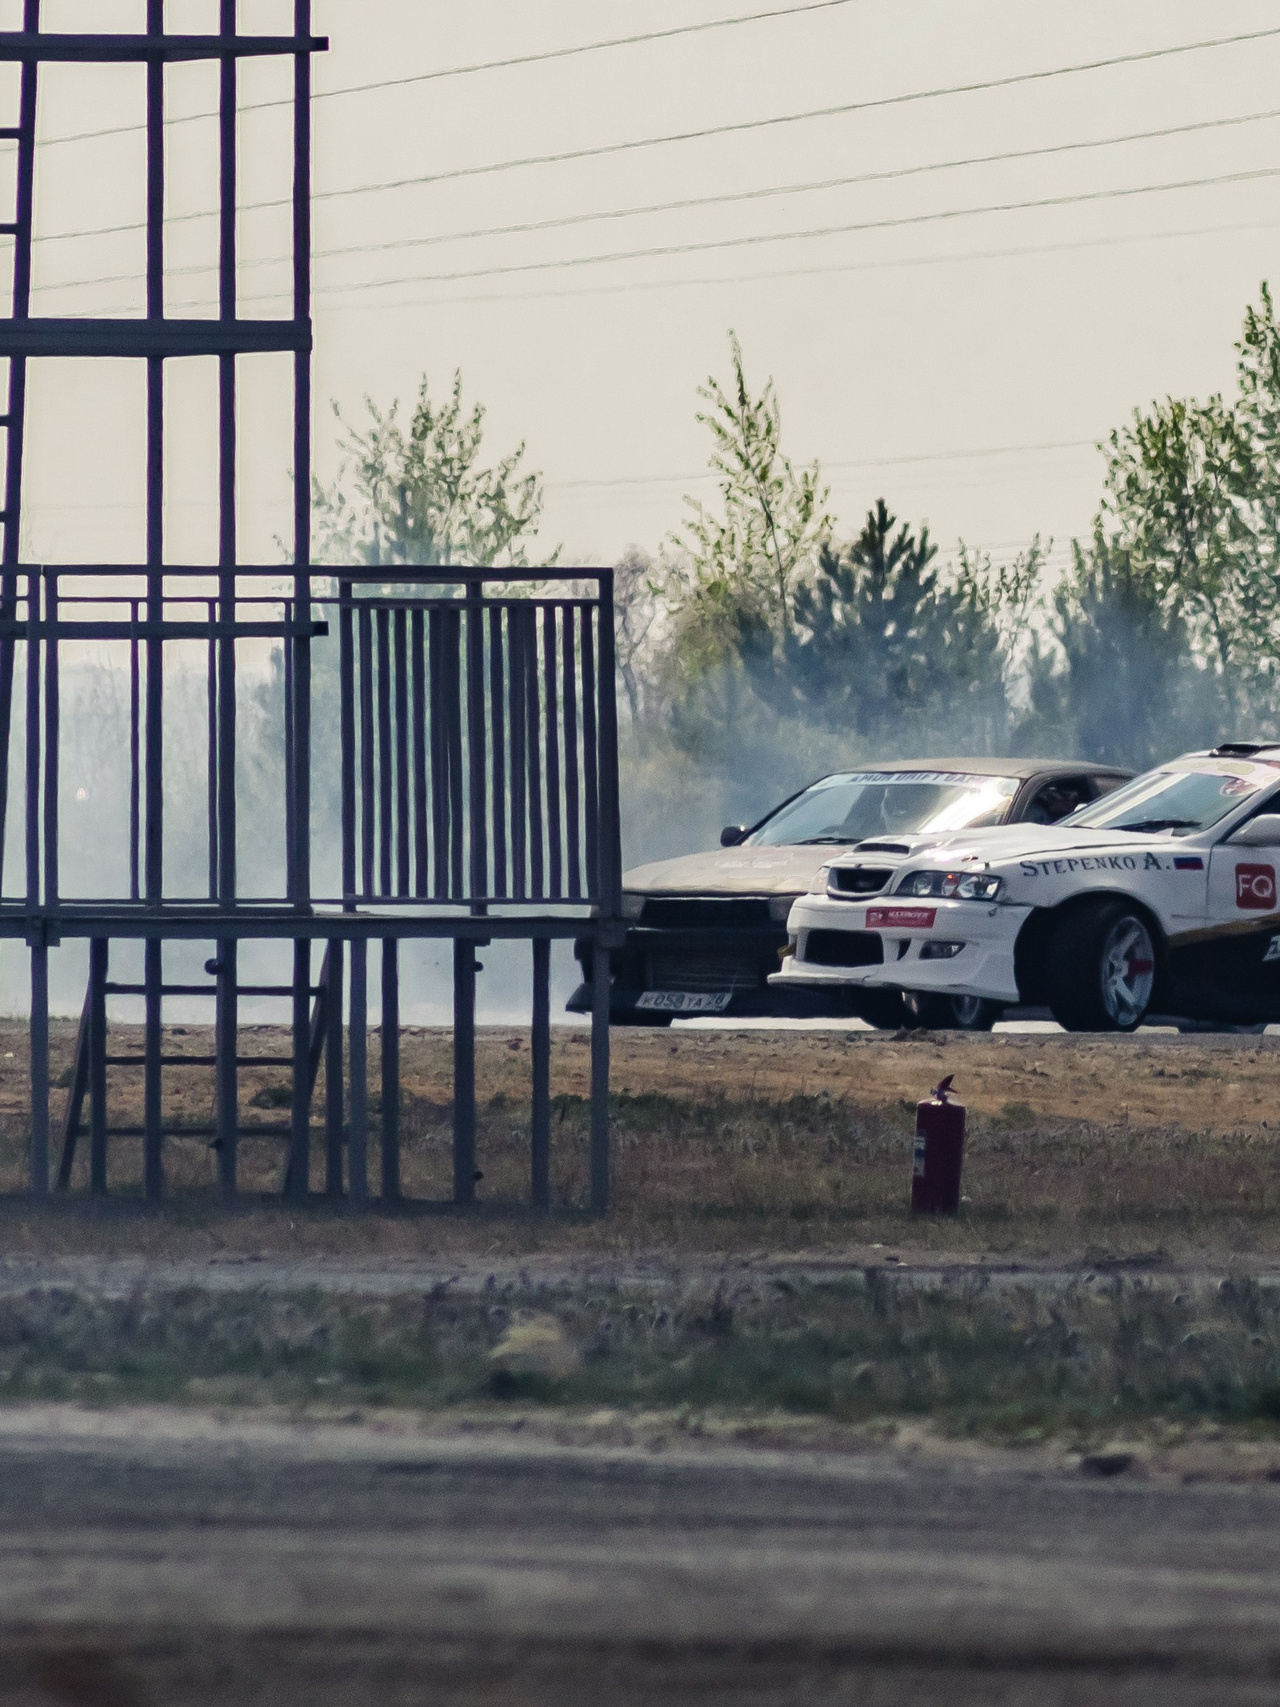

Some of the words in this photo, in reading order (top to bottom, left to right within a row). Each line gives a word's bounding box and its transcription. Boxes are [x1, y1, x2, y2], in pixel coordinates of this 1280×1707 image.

[1019, 856, 1136, 877] STEPENKO
[1143, 851, 1171, 871] A.
[1238, 874, 1274, 899] FQ
